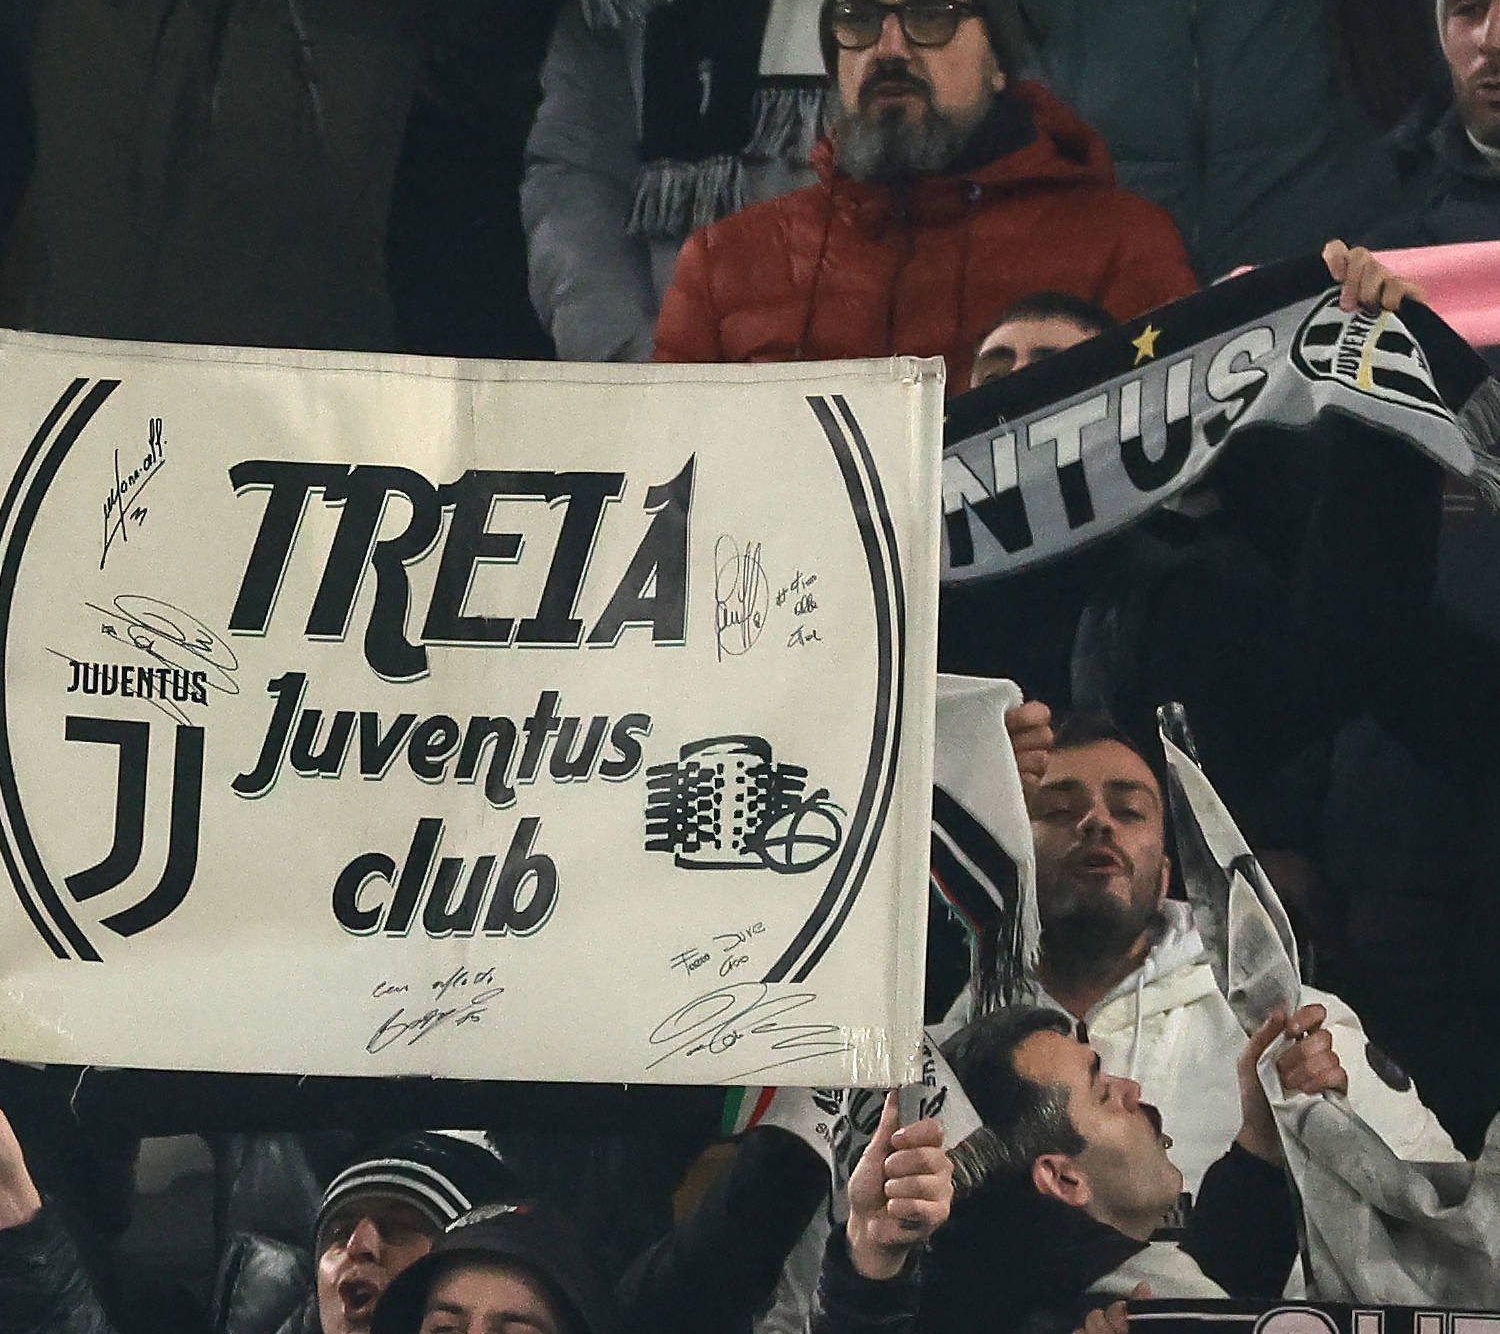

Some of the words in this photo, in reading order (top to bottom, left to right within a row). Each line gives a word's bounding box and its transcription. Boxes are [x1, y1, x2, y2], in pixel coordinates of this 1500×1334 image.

[942, 323, 1280, 567] NTUS
[228, 451, 697, 682] TREIA
[66, 660, 209, 708] JUVENTUS
[231, 670, 654, 809] Juventus
[331, 816, 562, 938] club
